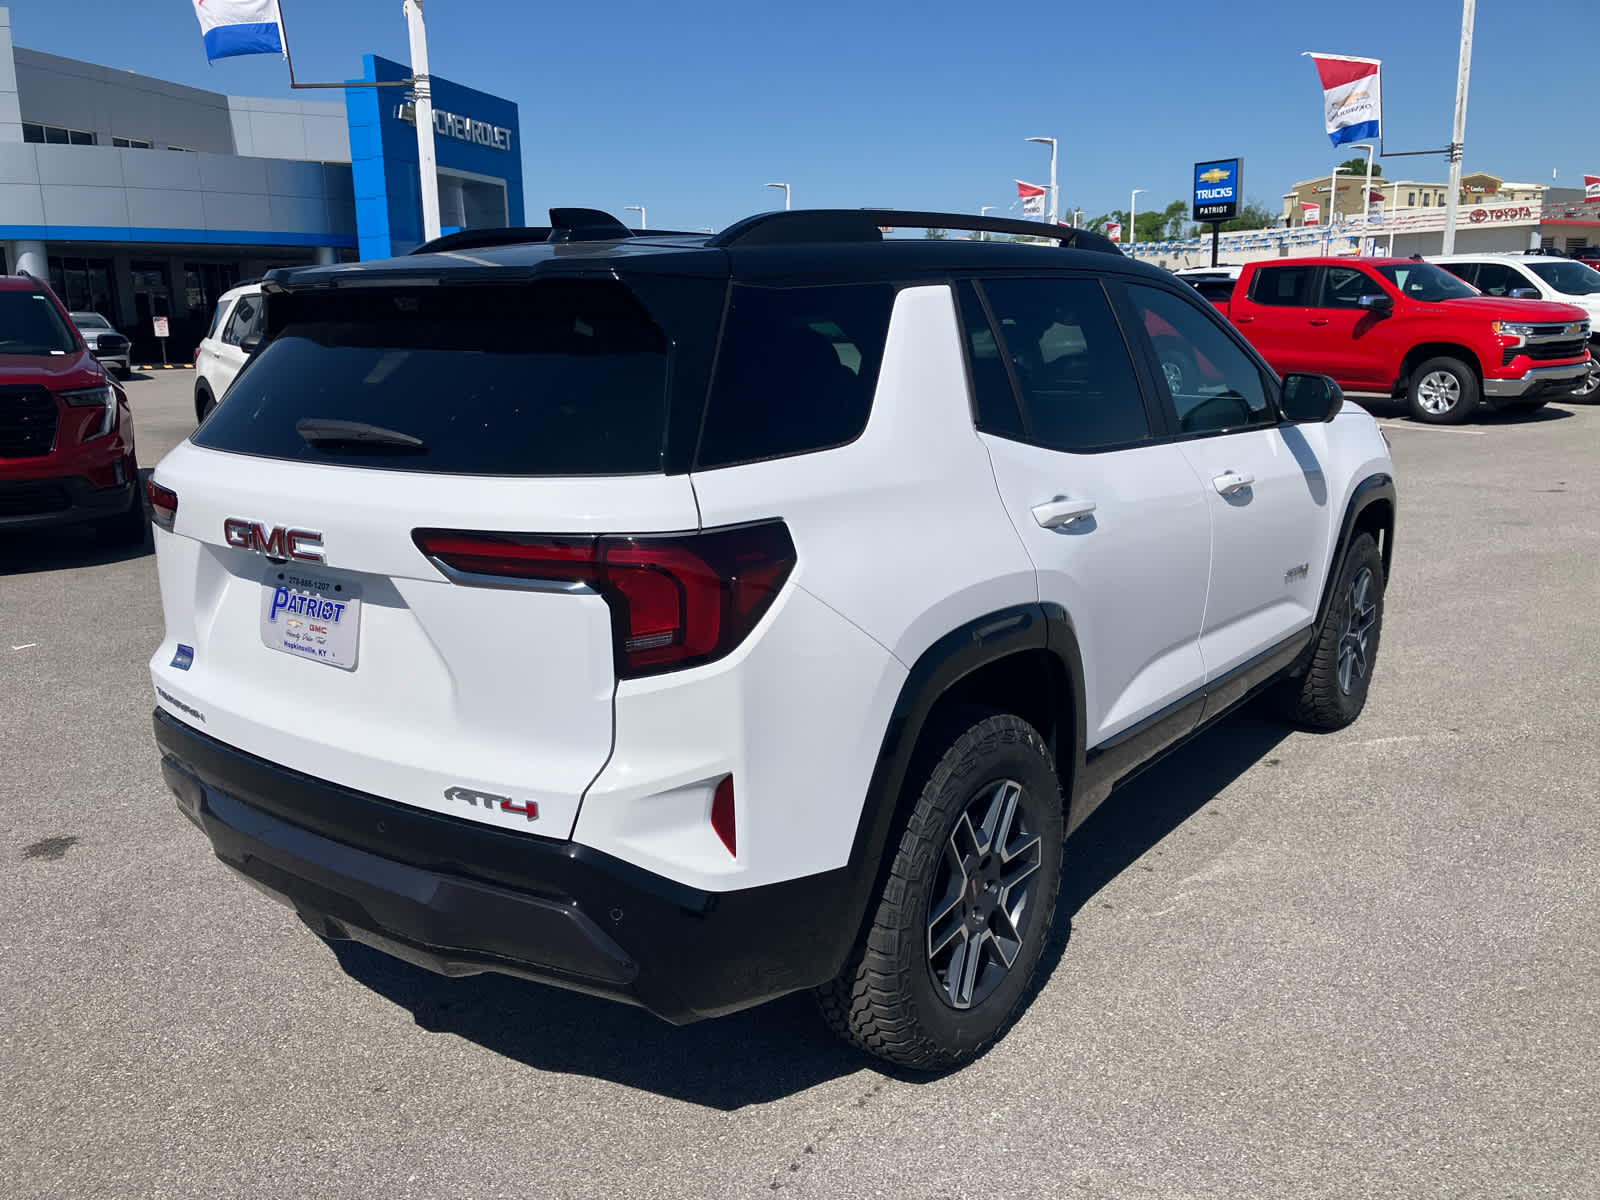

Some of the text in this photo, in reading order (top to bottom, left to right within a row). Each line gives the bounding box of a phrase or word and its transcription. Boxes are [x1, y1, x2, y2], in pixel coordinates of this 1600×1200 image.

[431, 108, 512, 151] CHEVROLET
[1195, 186, 1233, 200] TRUCKS
[1199, 205, 1228, 215] PATRIOT
[1487, 206, 1532, 220] TOYOTA
[224, 517, 328, 566] GMC
[270, 587, 345, 622] PATRIOT
[309, 624, 328, 635] GMC
[318, 648, 327, 657] KY
[443, 785, 540, 823] AT4
